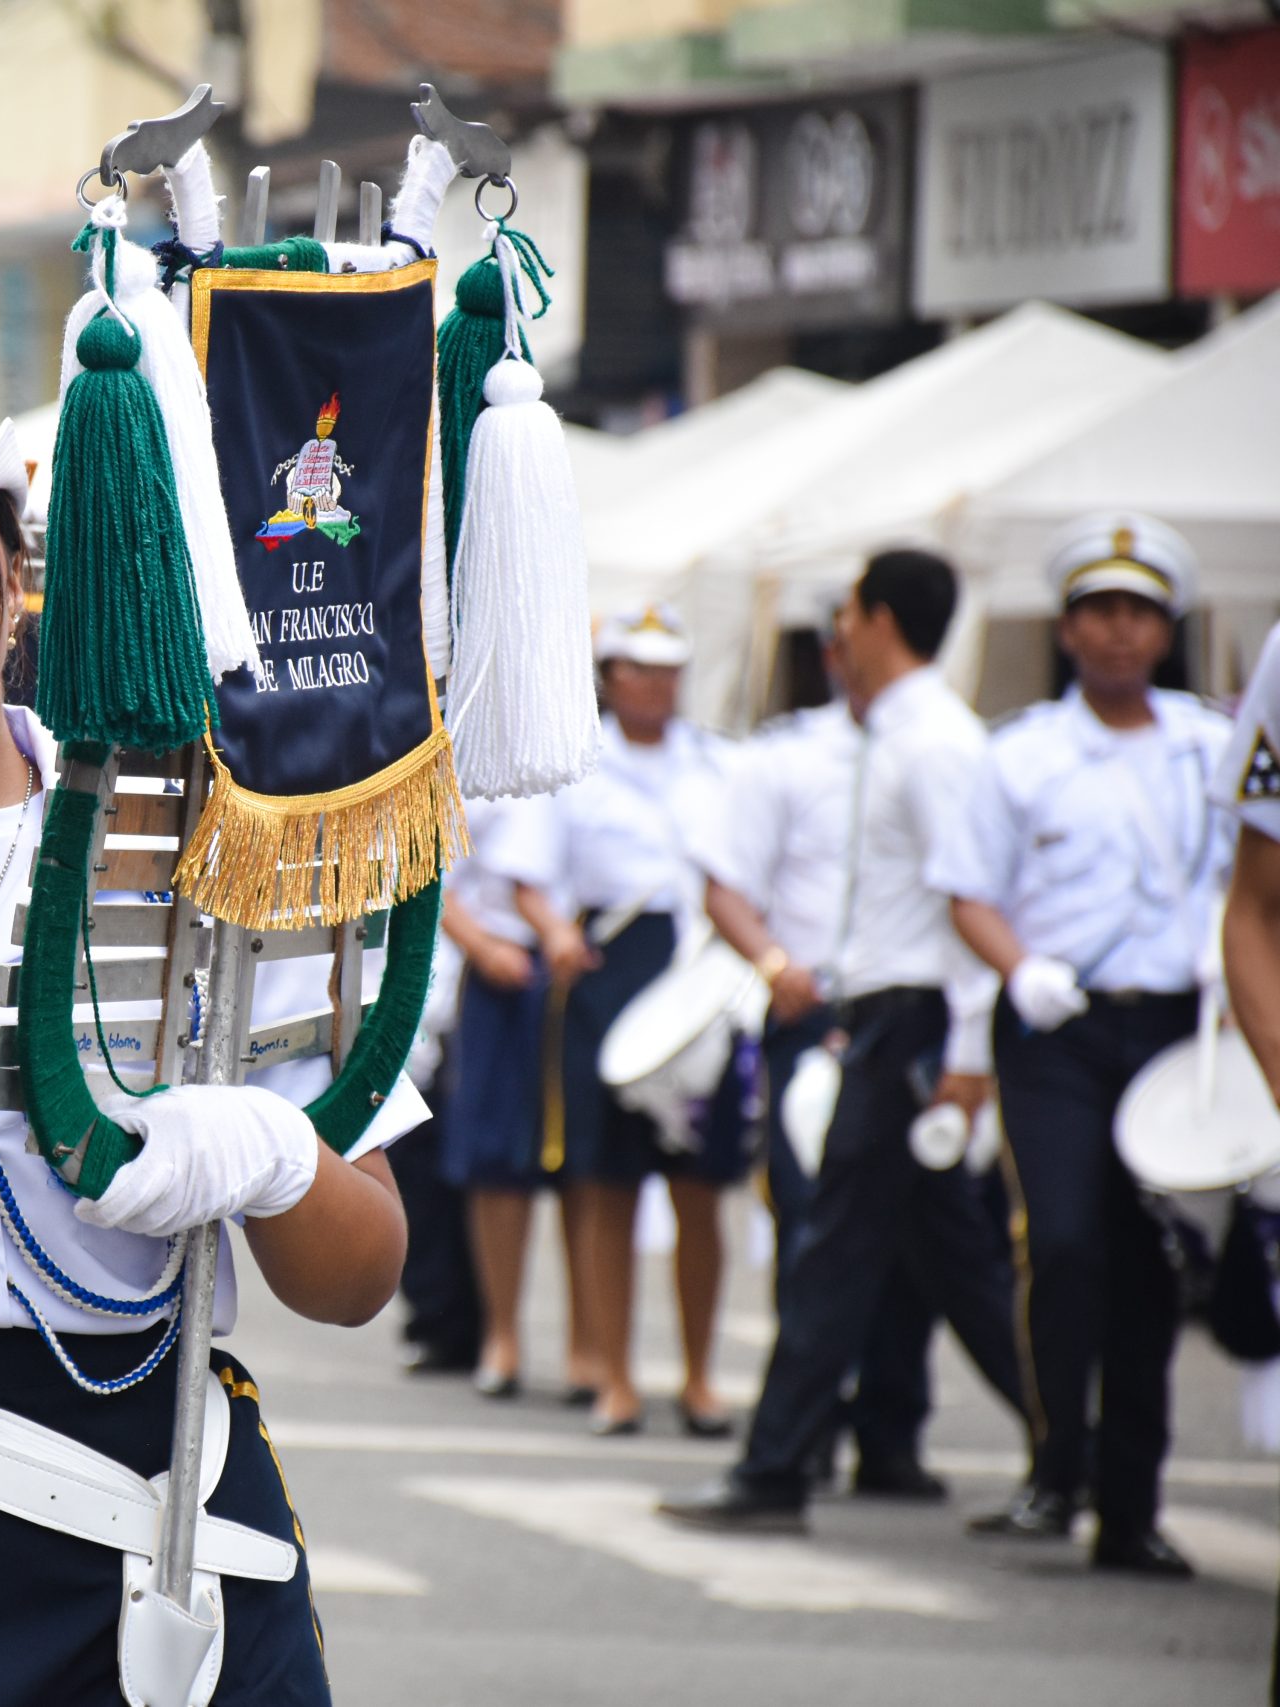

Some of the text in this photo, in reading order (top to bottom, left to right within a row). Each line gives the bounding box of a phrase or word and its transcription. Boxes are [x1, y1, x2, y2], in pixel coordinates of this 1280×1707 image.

[292, 561, 325, 593] U.E
[250, 602, 374, 644] AN FRANCISCO
[256, 651, 369, 693] DE MILAGRO
